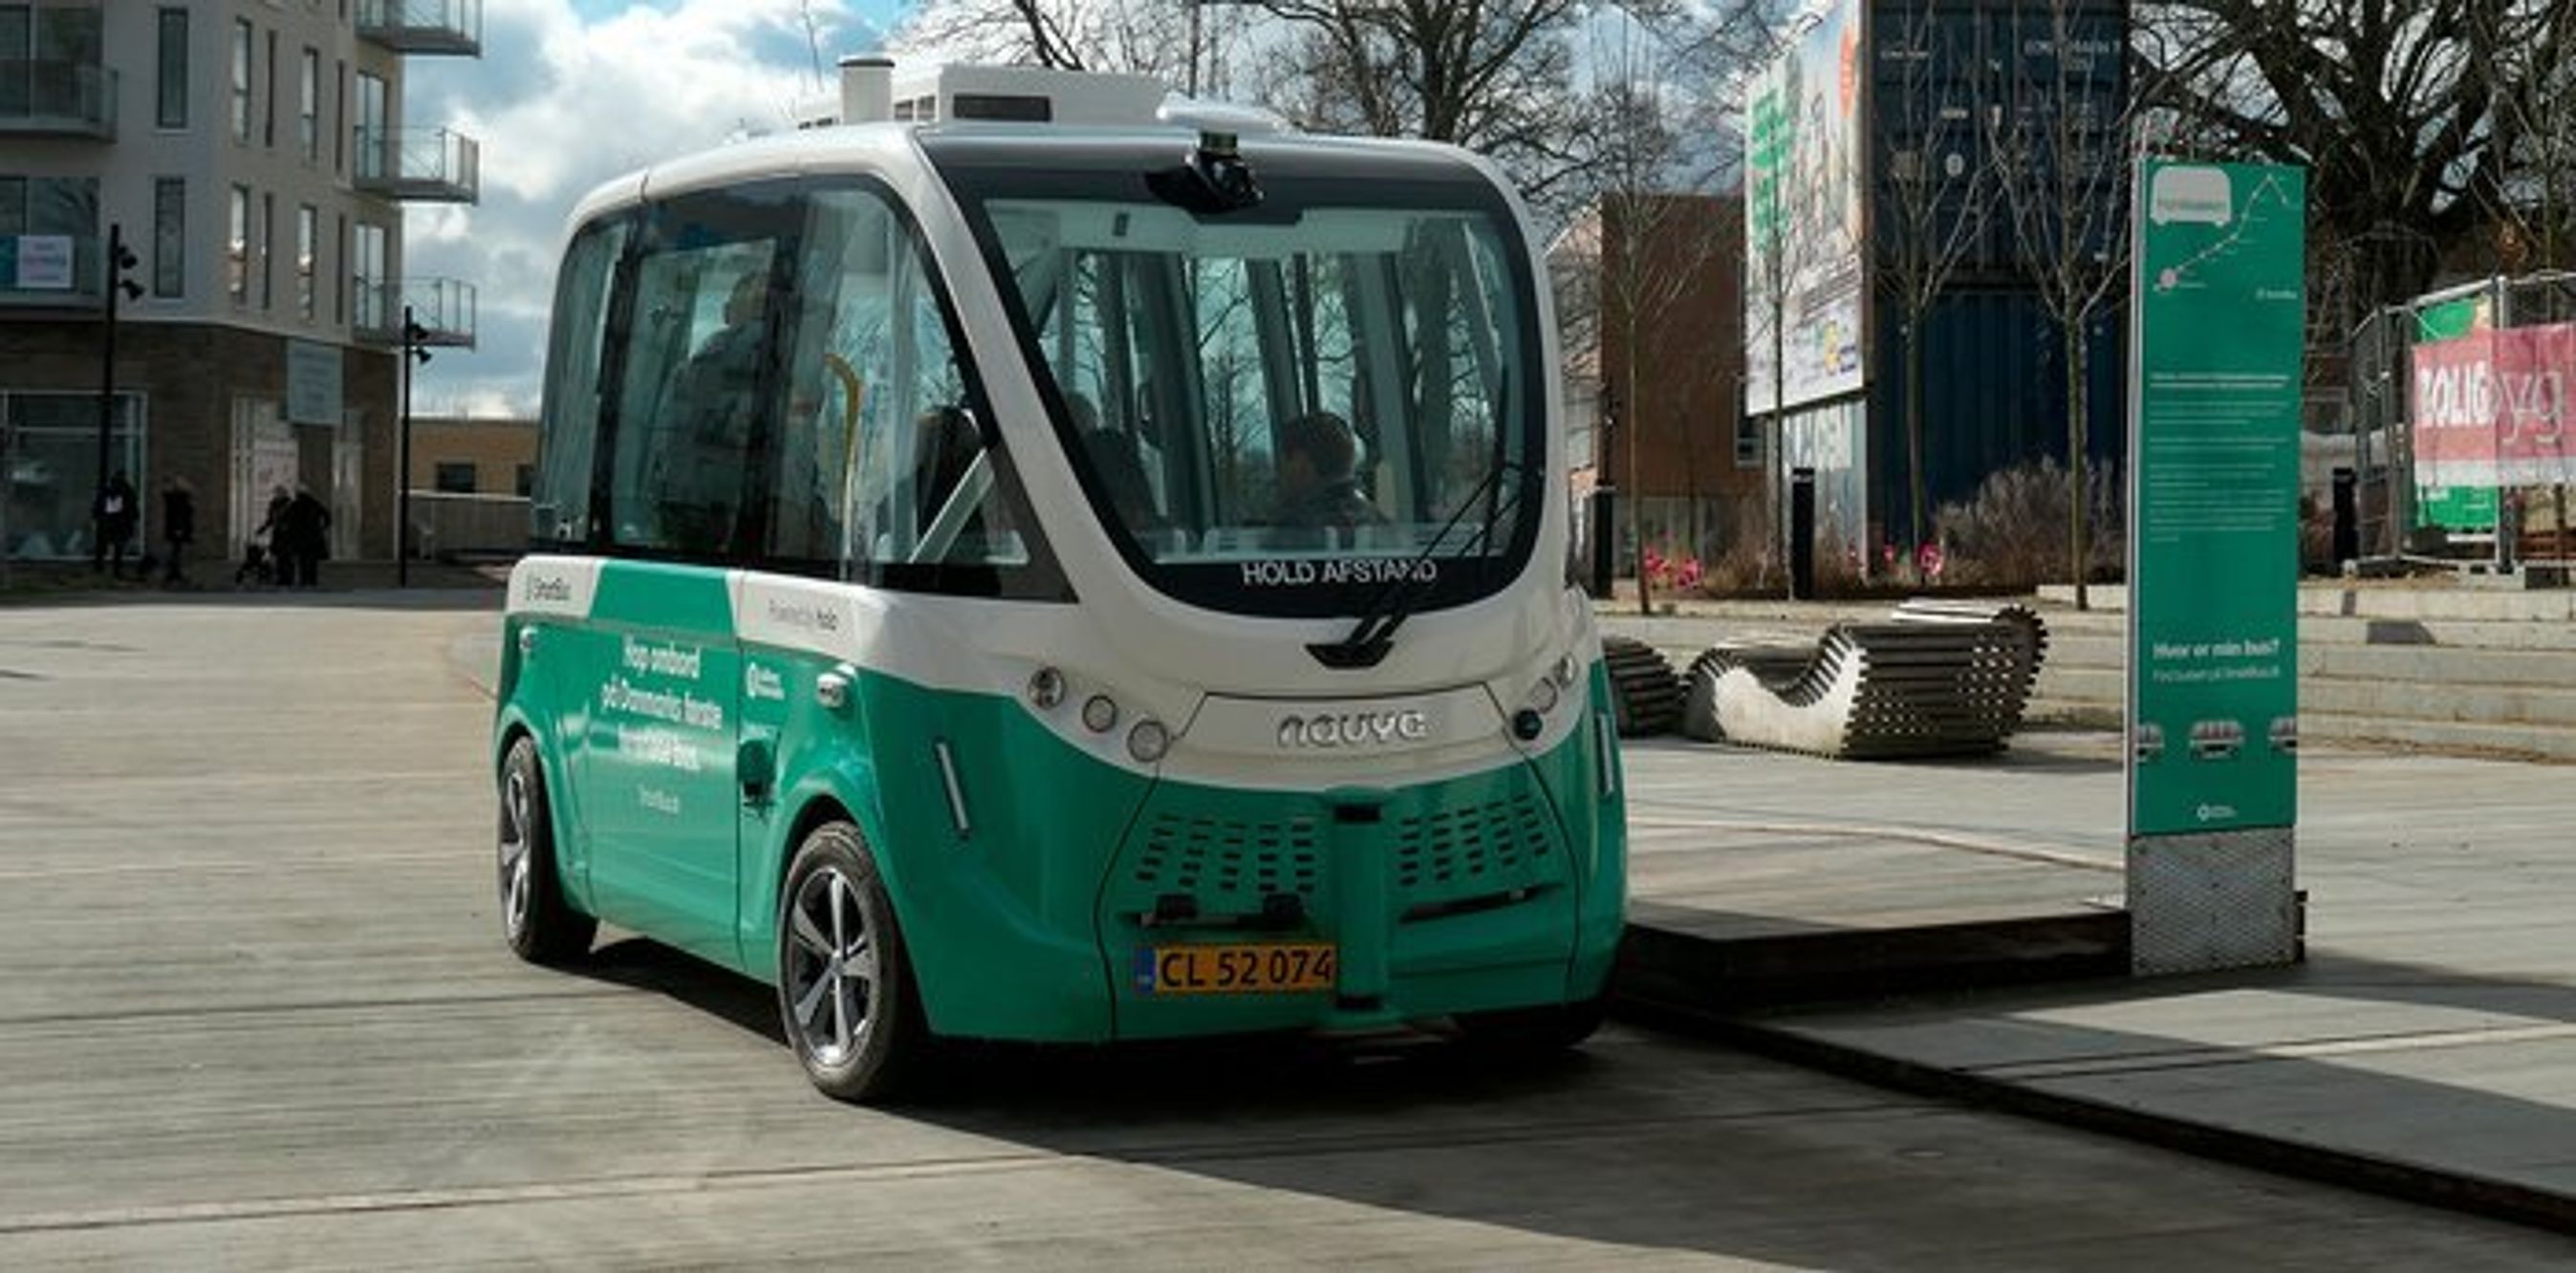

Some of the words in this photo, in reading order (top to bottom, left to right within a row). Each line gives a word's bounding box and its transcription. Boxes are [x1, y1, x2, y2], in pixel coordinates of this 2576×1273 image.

[1243, 558, 1315, 585] HOLD
[651, 639, 700, 679] ombord
[2153, 642, 2189, 659] Hvor
[2212, 638, 2242, 658] min
[2244, 637, 2280, 657] bus?
[1161, 953, 1205, 987] CL
[1218, 952, 1259, 986] 52
[1268, 949, 1332, 984] 074
